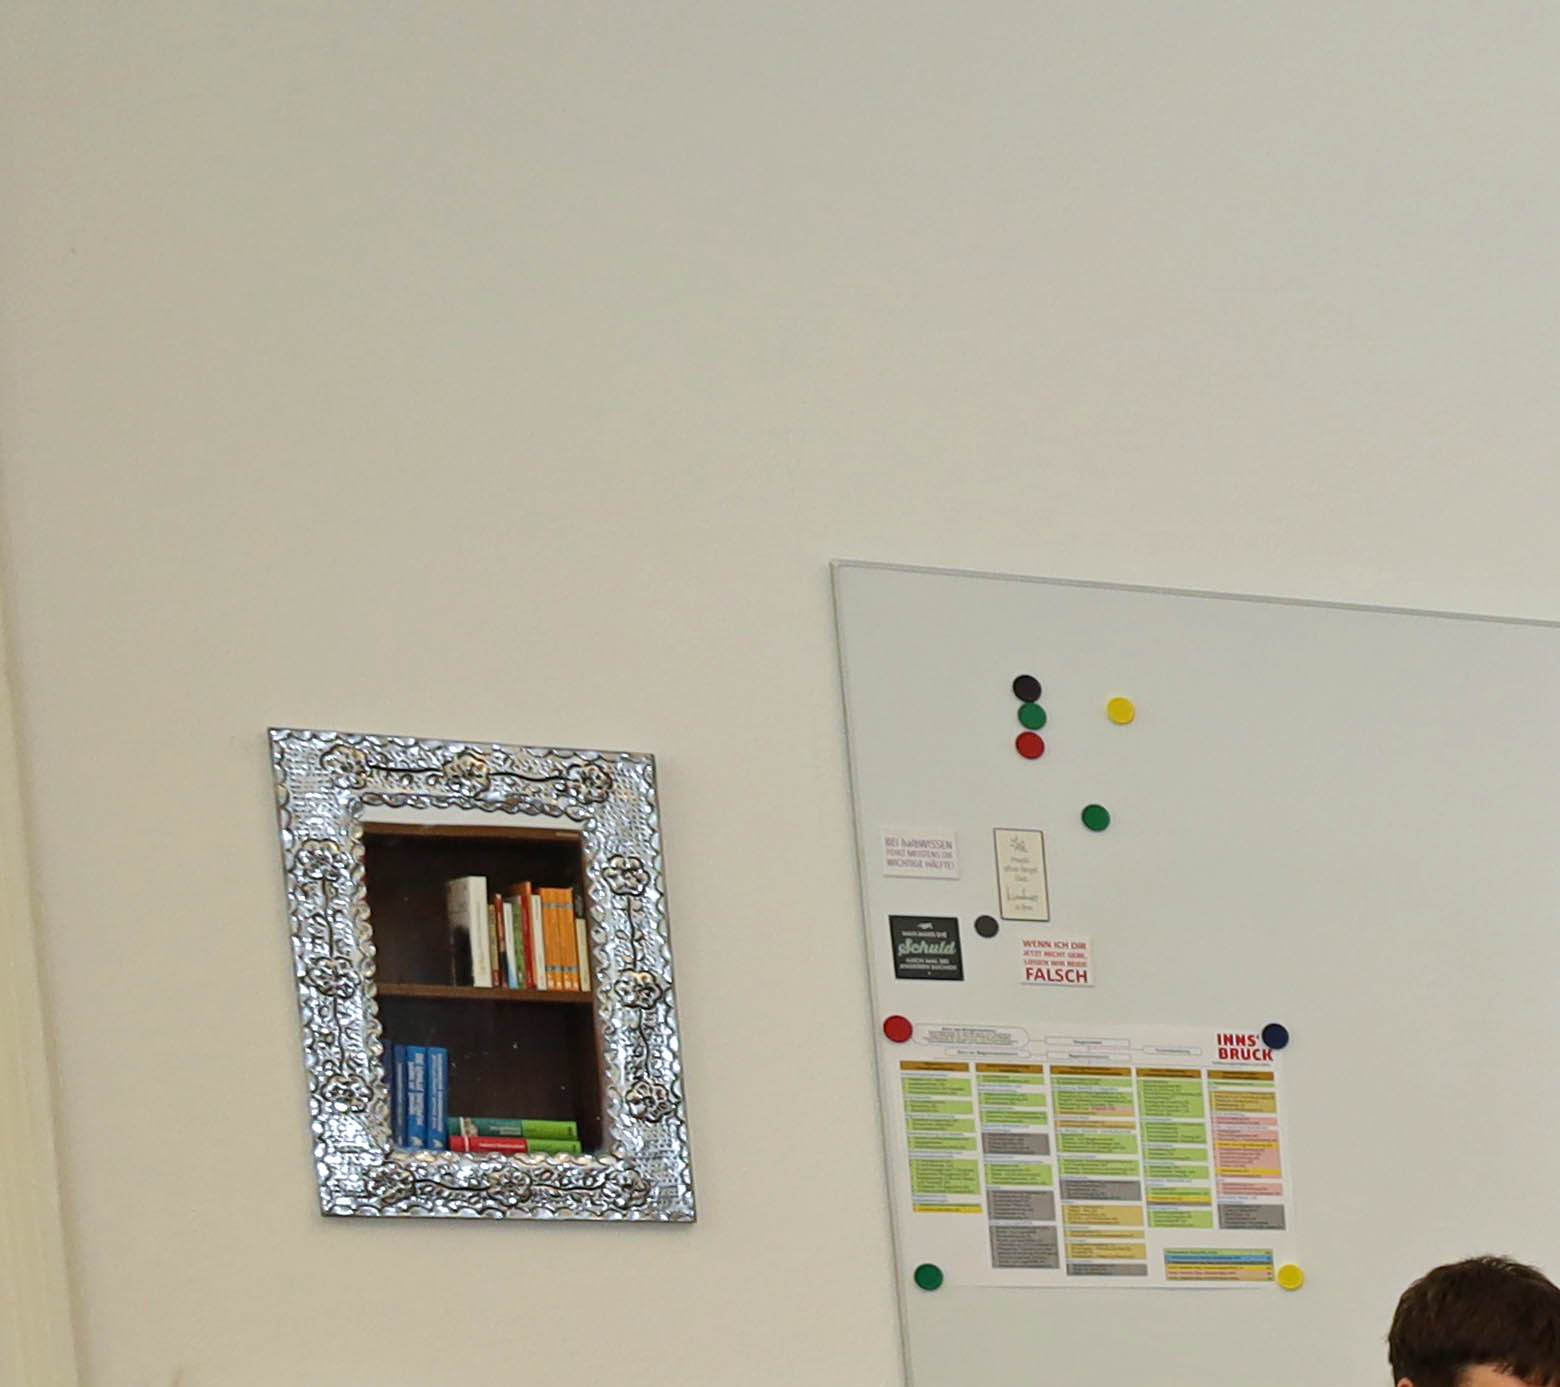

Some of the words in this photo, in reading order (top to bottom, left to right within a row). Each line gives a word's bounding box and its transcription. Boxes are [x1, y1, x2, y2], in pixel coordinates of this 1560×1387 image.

[898, 938, 956, 957] Schuld
[1023, 940, 1052, 949] WENN
[1053, 941, 1069, 949] ICH
[1071, 942, 1087, 950] DIR
[1025, 967, 1088, 984] FALSCH
[1218, 1047, 1274, 1062] BRUCK
